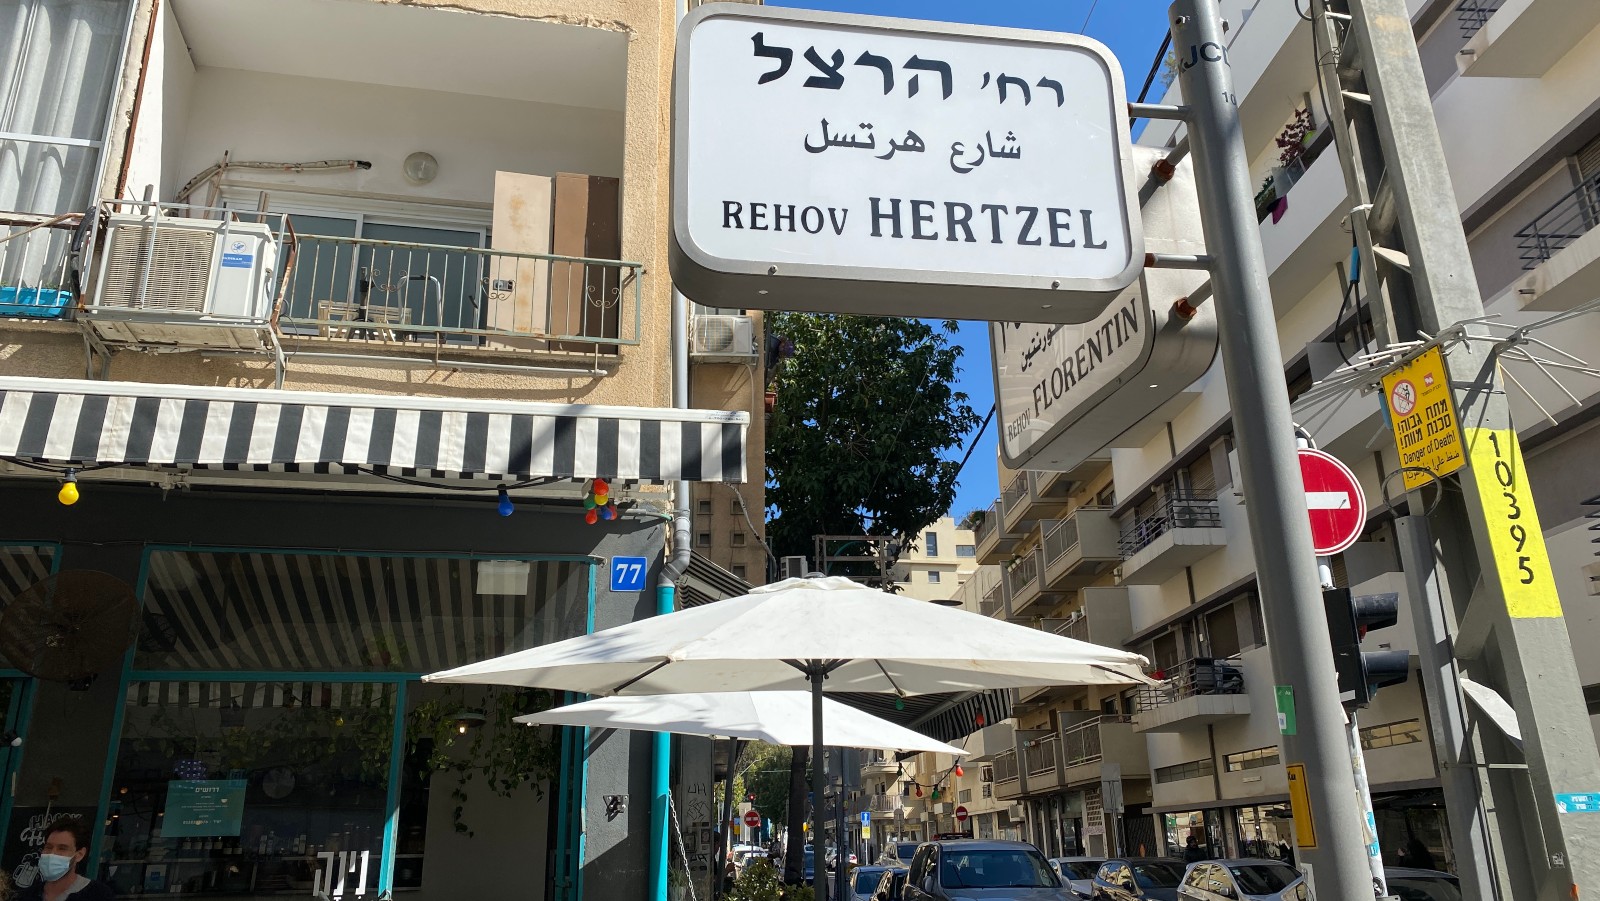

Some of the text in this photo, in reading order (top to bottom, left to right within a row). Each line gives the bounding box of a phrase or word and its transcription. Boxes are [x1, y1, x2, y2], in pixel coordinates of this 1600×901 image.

[751, 32, 1064, 107] רח' הרצל
[804, 118, 1021, 174] شارع هرتسل
[722, 197, 1108, 249] REHOV HERTZEL
[1007, 298, 1139, 442] REHOV FLORENTIN
[1397, 399, 1448, 435] מתח גבוה!
[1400, 413, 1451, 449] סכנת מוות!
[1403, 430, 1457, 465] Danger of Death!
[1489, 431, 1534, 584] 10395
[615, 563, 642, 584] 77
